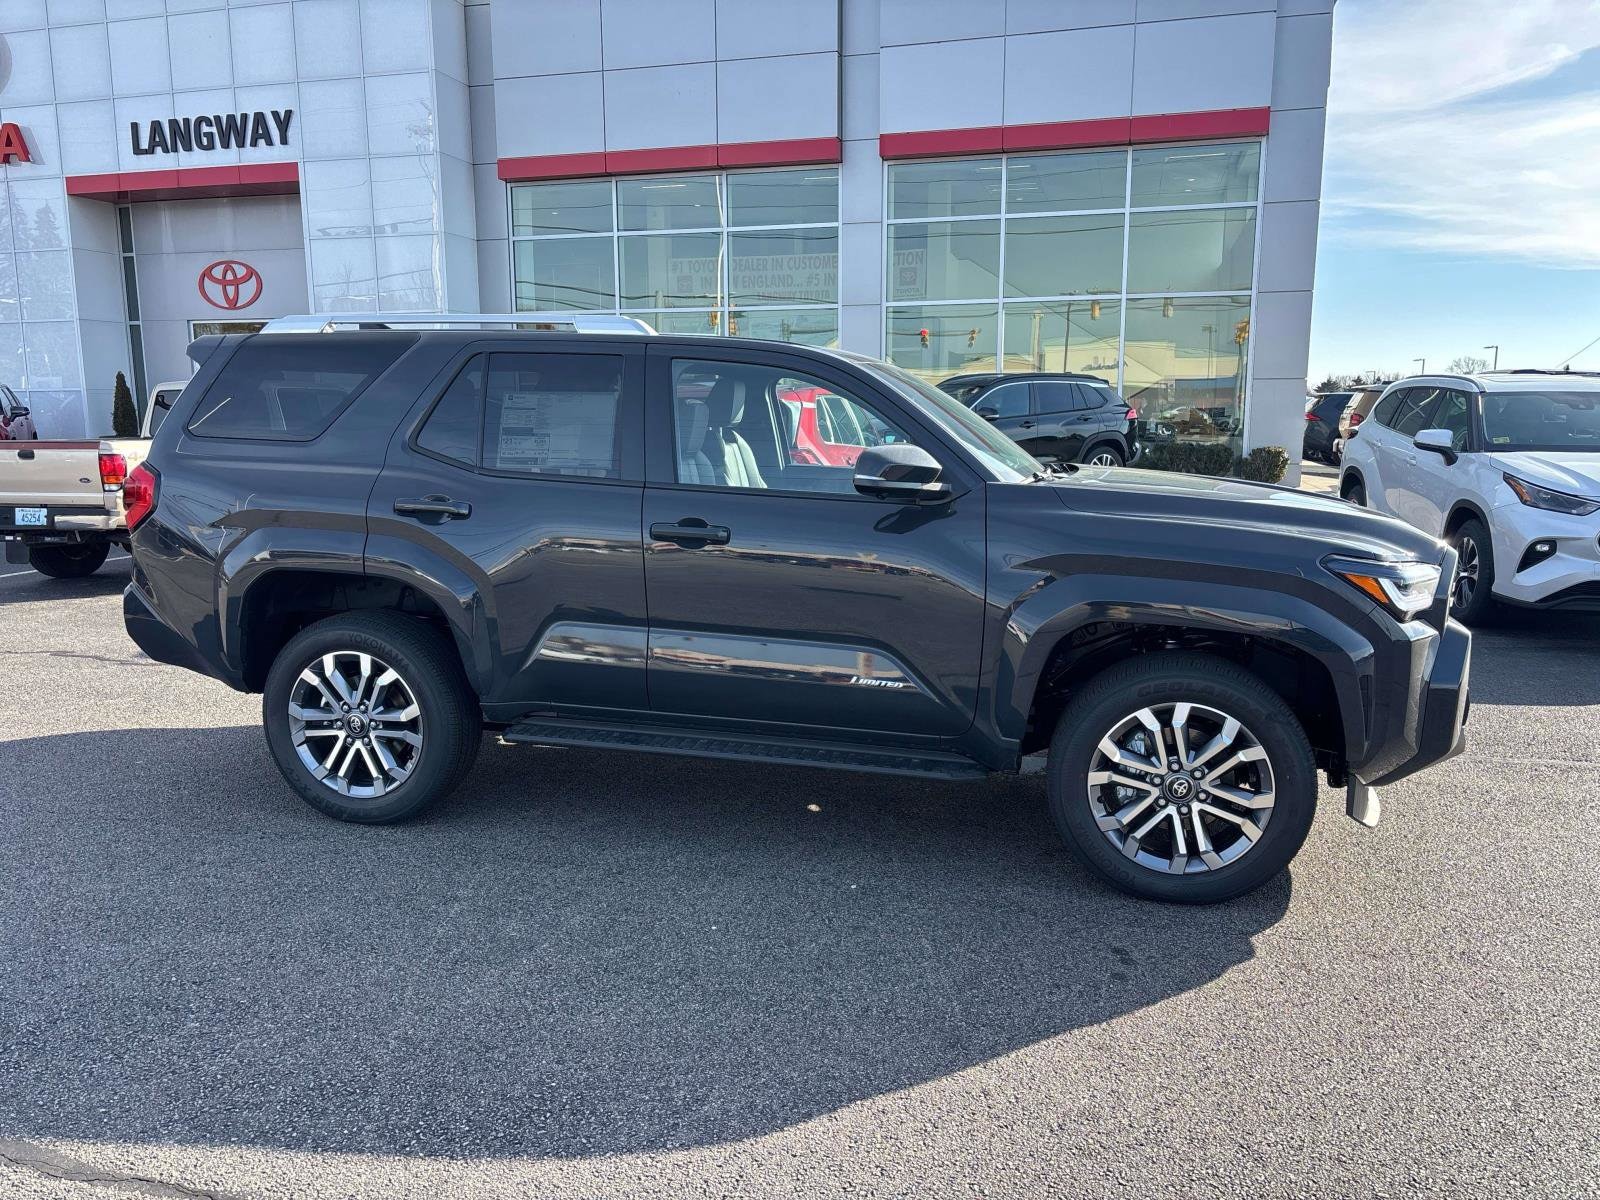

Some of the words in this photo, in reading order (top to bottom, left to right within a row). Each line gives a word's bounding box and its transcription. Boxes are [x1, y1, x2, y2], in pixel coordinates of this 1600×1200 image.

[130, 109, 293, 156] LANGWAY
[688, 259, 718, 273] TOYO
[733, 257, 768, 273] DEALER
[772, 257, 784, 271] IN
[786, 255, 838, 271] CUSTOME
[895, 251, 924, 266] TION
[700, 276, 713, 290] IN
[824, 272, 836, 287] IN
[849, 676, 904, 688] LIMITED
